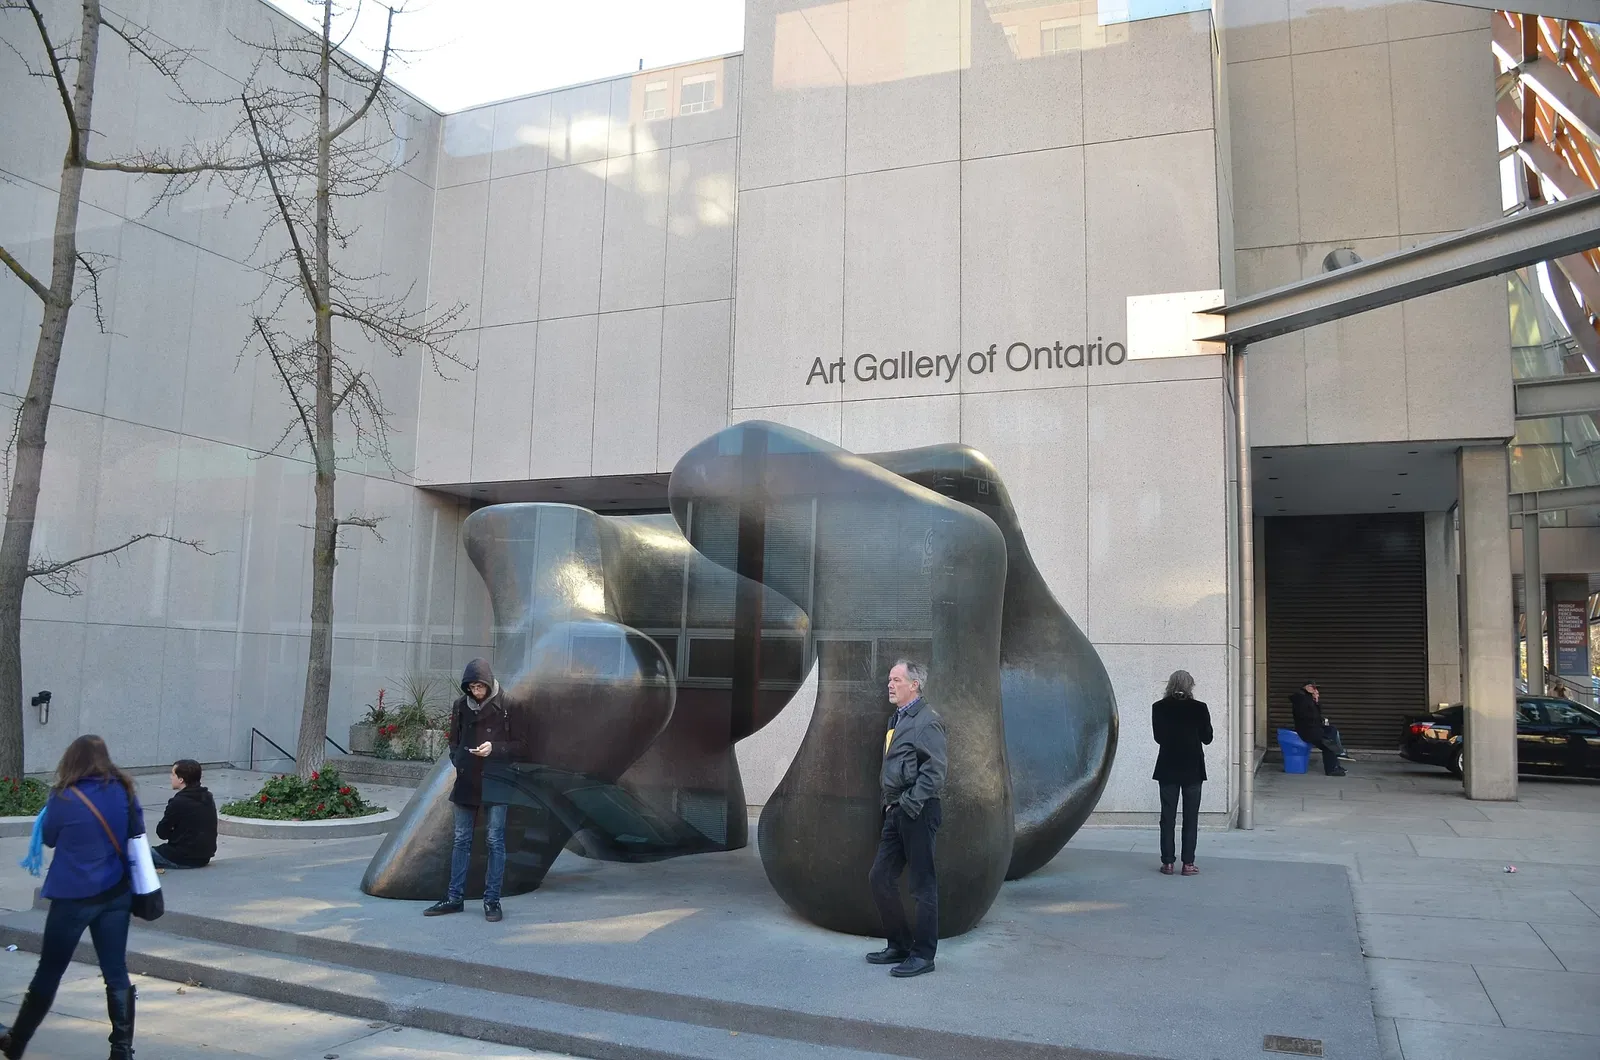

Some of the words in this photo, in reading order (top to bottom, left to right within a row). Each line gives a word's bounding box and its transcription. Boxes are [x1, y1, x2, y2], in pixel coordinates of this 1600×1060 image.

[805, 356, 846, 386] Art
[853, 350, 961, 383] Gallery
[967, 343, 997, 375] of
[1005, 336, 1126, 372] Ontario
